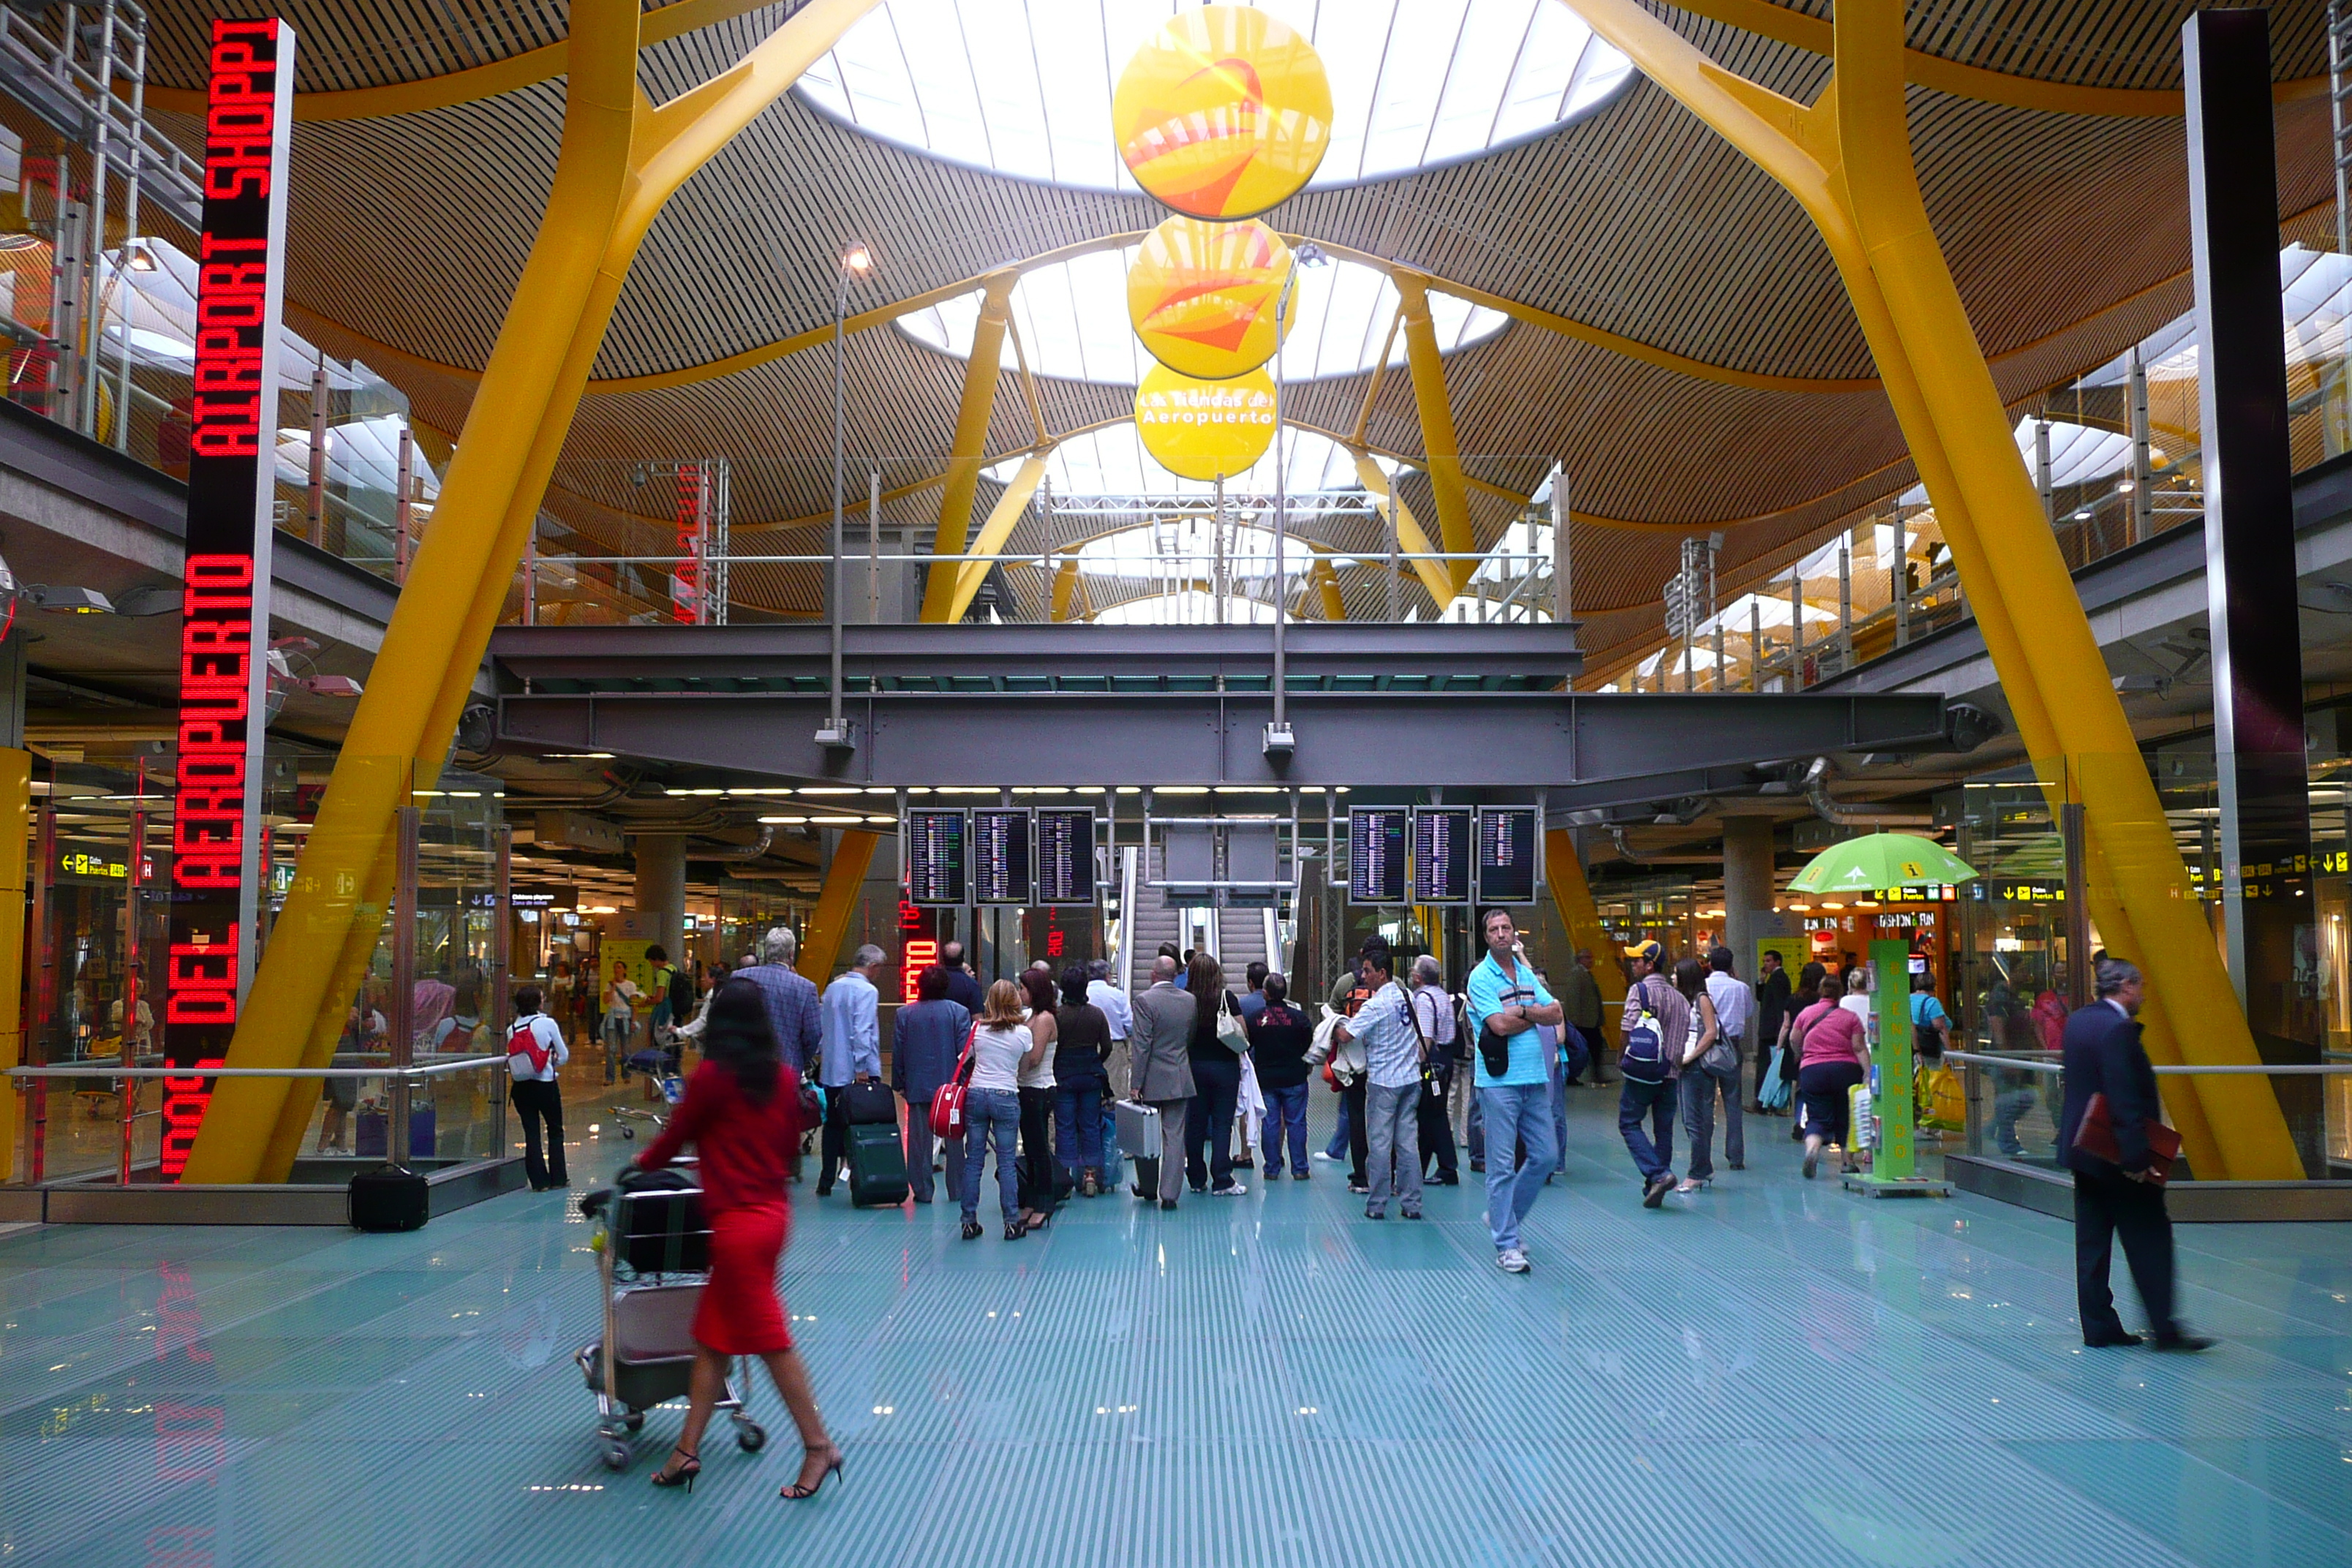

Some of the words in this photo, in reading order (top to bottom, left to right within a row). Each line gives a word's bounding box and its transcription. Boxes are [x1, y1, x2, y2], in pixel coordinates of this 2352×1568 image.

[204, 18, 279, 200] SHOPPI
[191, 232, 268, 457] AIRPORT
[1141, 393, 1166, 407] Las
[1172, 393, 1242, 407] Tiendas
[1248, 393, 1275, 407] del
[1142, 412, 1273, 426] Aeropuerto
[173, 554, 254, 889] AEROPUERTO
[167, 923, 239, 1024] DEL
[1919, 912, 1934, 927] FUN
[1889, 961, 1907, 1159] BIENVENIDO
